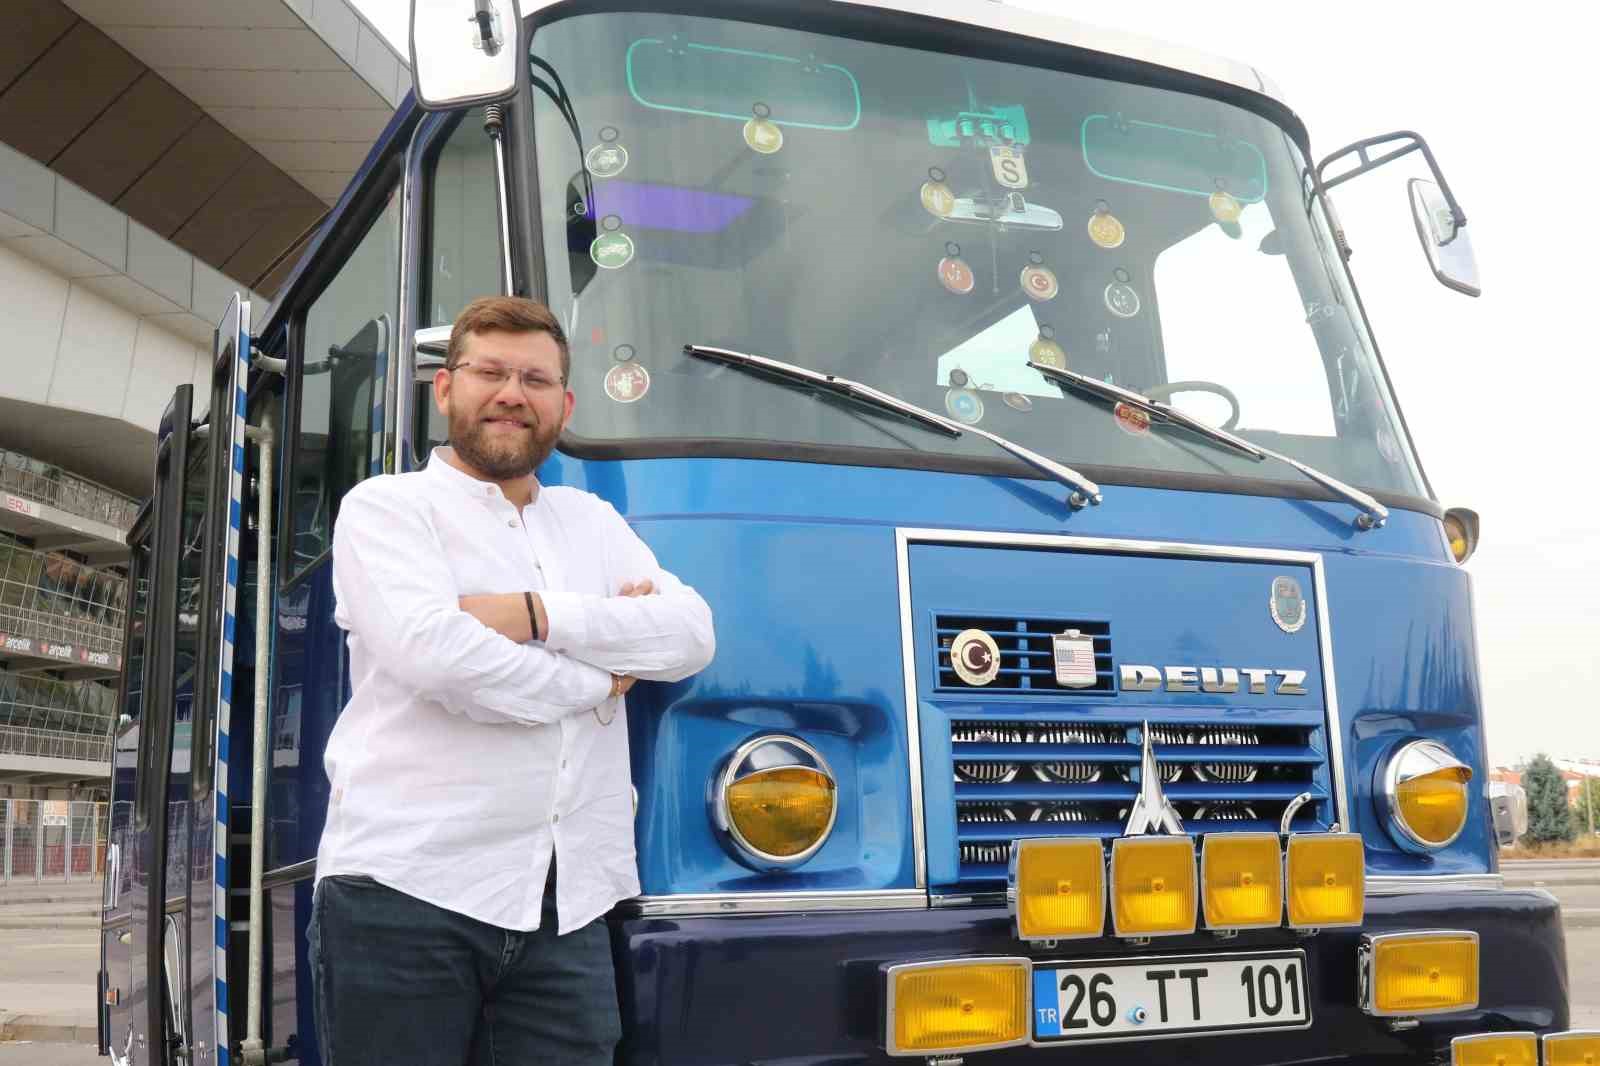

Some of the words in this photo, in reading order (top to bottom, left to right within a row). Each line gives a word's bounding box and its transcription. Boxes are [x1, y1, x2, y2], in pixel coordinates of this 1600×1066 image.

[1119, 664, 1307, 695] DEUTZ
[1060, 973, 1116, 1029] 26
[1146, 968, 1208, 1023] TT
[1241, 963, 1300, 1018] 101
[1038, 1007, 1057, 1024] TR
